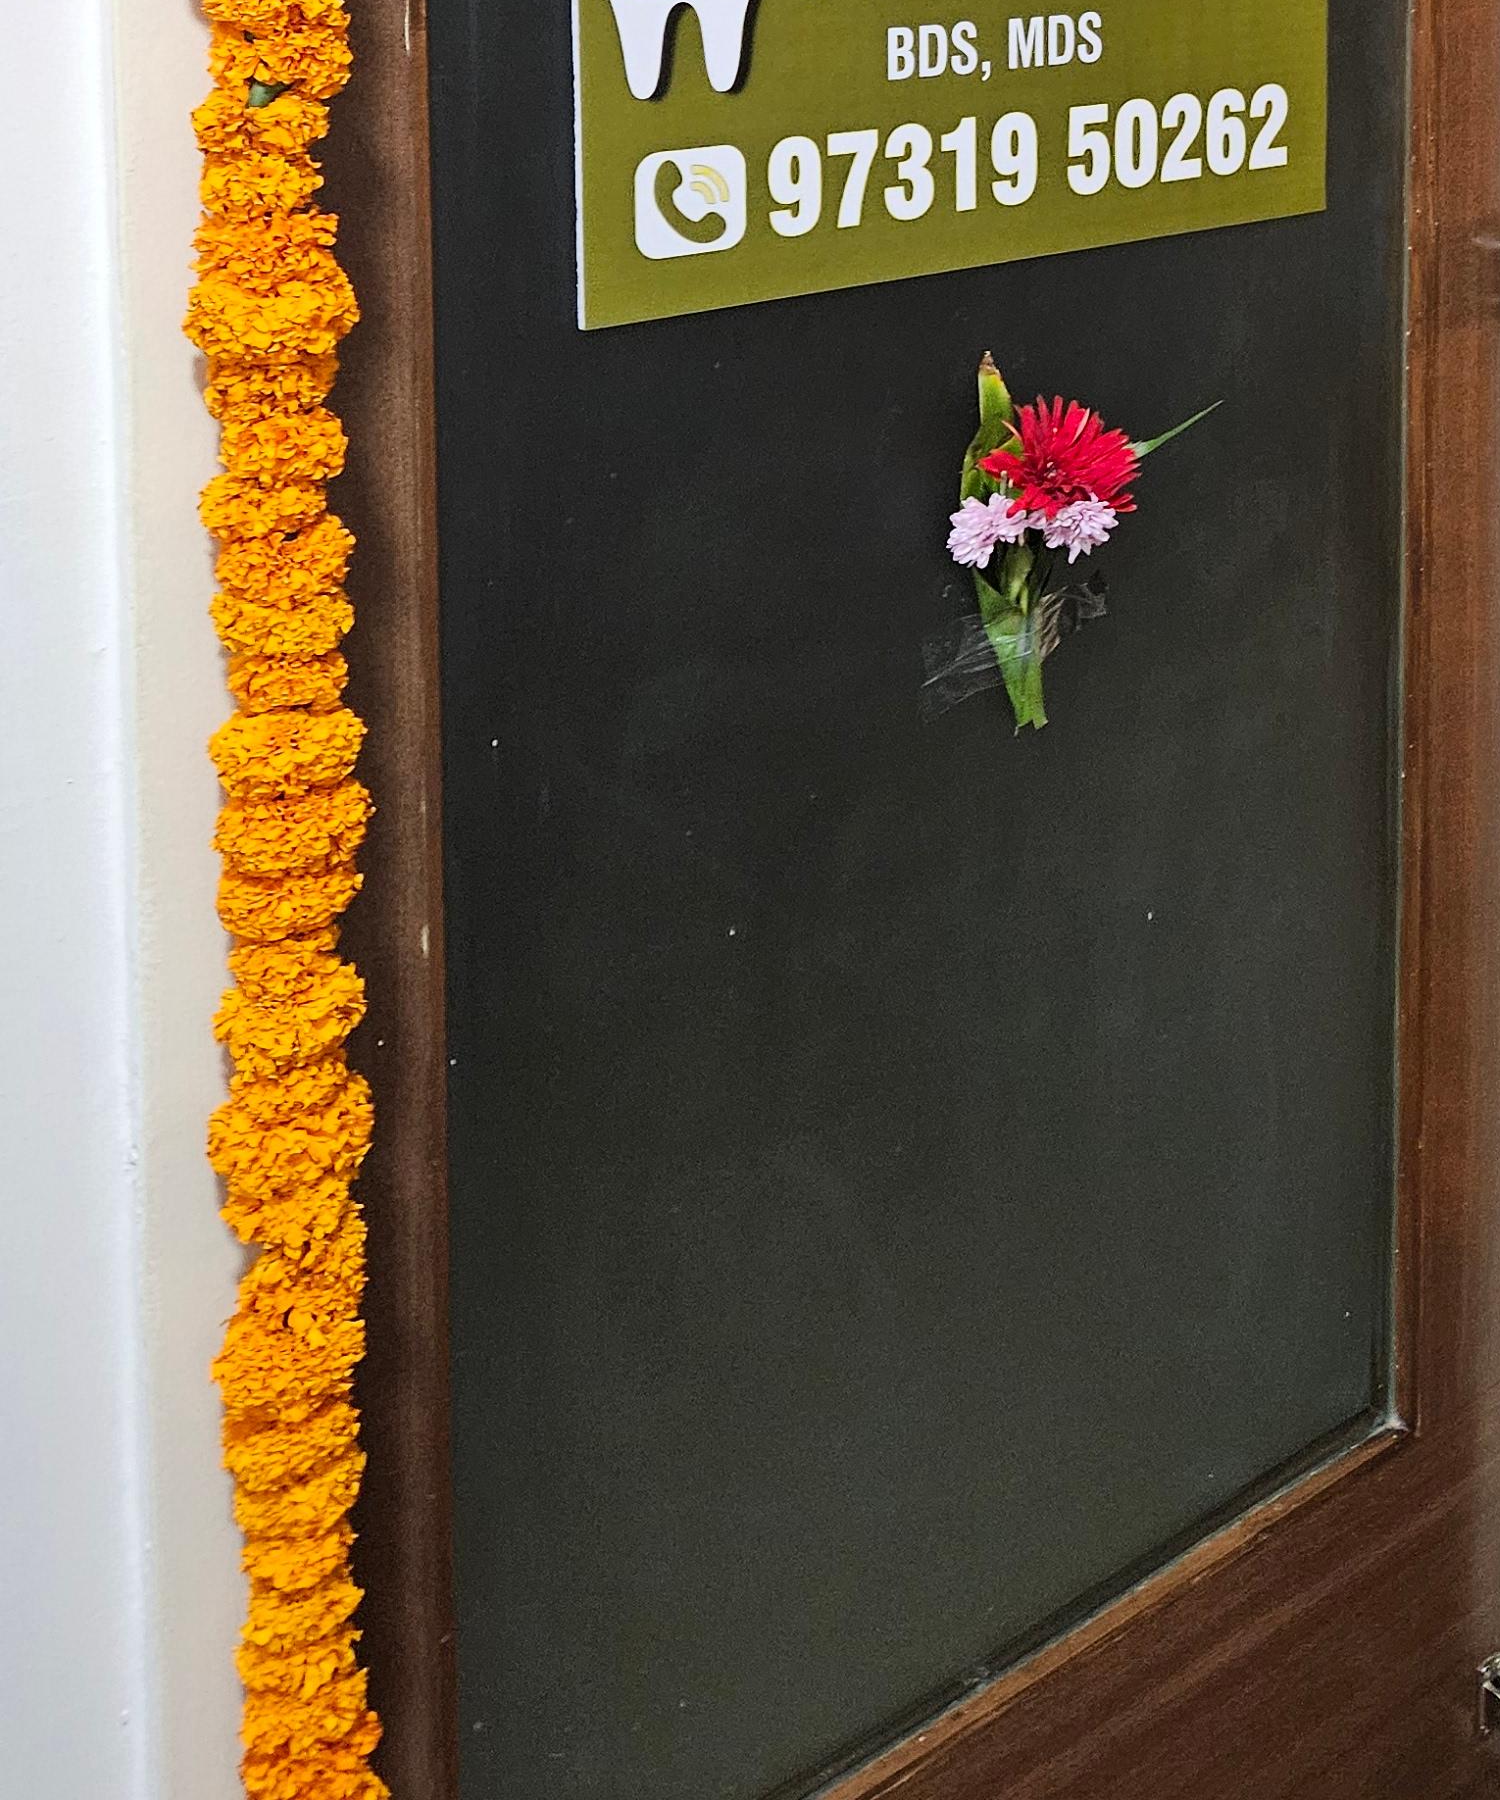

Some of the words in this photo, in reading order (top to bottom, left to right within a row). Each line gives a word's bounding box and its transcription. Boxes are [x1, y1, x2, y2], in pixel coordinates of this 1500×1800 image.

[887, 21, 992, 82] BDS,
[1007, 10, 1104, 70] MDS
[768, 111, 1038, 238] 97319
[1067, 83, 1289, 197] 50262
